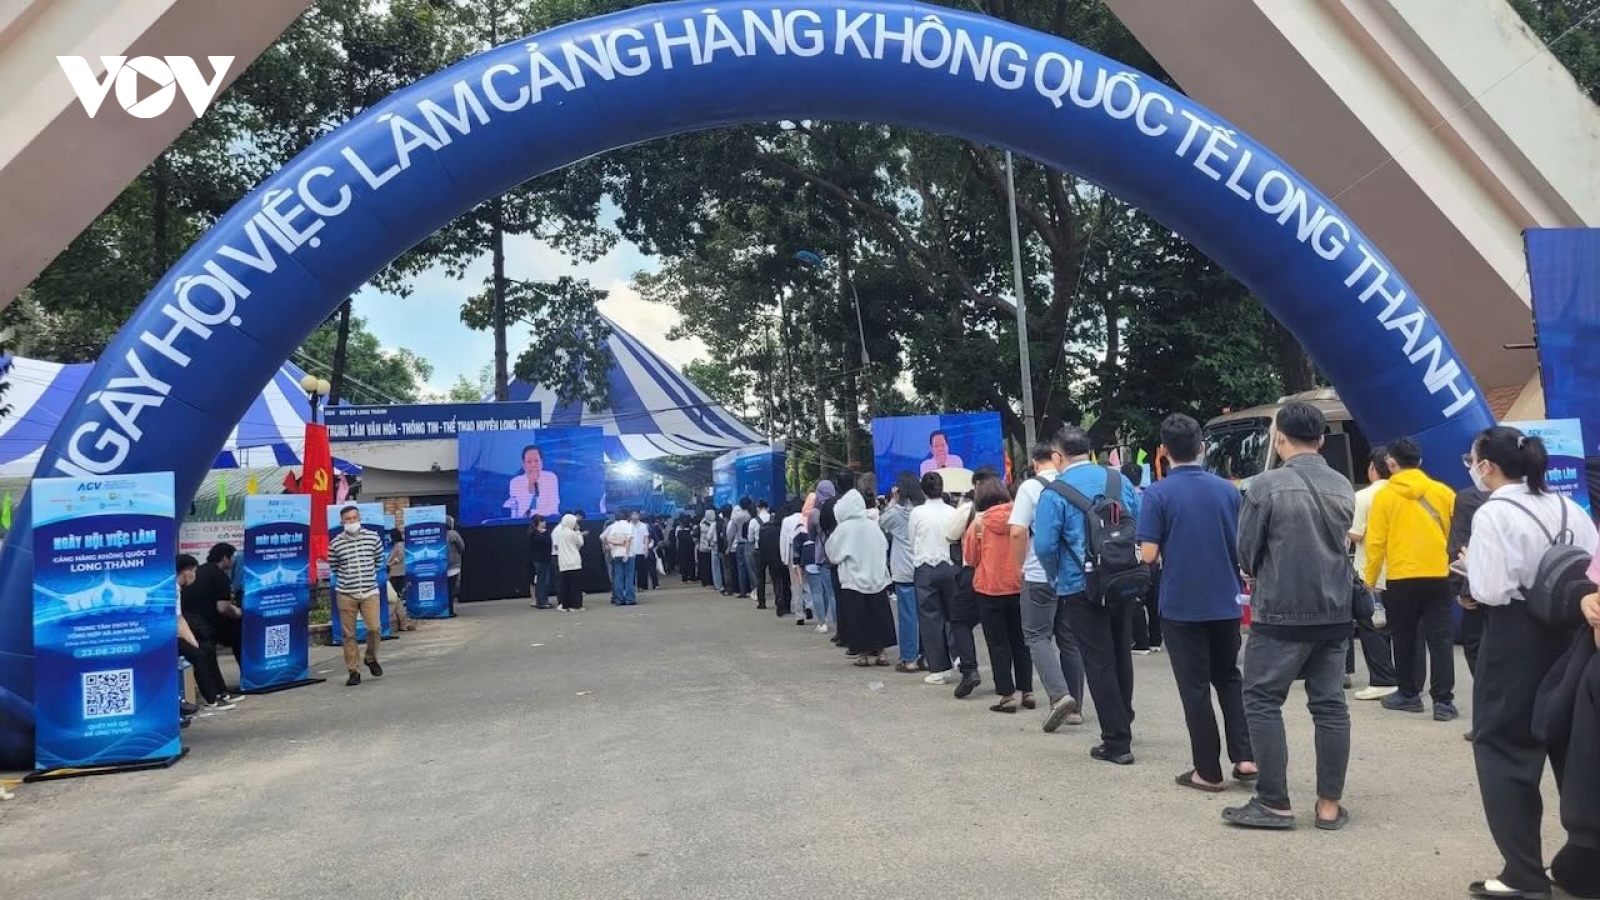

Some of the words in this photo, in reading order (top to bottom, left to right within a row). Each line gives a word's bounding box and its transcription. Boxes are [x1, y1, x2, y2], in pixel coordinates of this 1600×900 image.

[140, 259, 251, 367] HỘI
[217, 166, 352, 274] VIỆC
[341, 79, 491, 191] LÀM
[481, 28, 652, 113] CẢNG
[654, 8, 825, 70] HÀNG
[835, 9, 1028, 91] KHÔNG
[1034, 51, 1174, 137] QUỐC
[1175, 109, 1238, 181] TẾ
[1225, 149, 1350, 261] LONG
[1344, 243, 1476, 418] THÀNH
[350, 421, 366, 437] TÂM
[105, 530, 130, 548] VIỆC
[132, 528, 156, 545] LÀM
[70, 562, 102, 573] LONG
[104, 558, 144, 571] THÀNH
